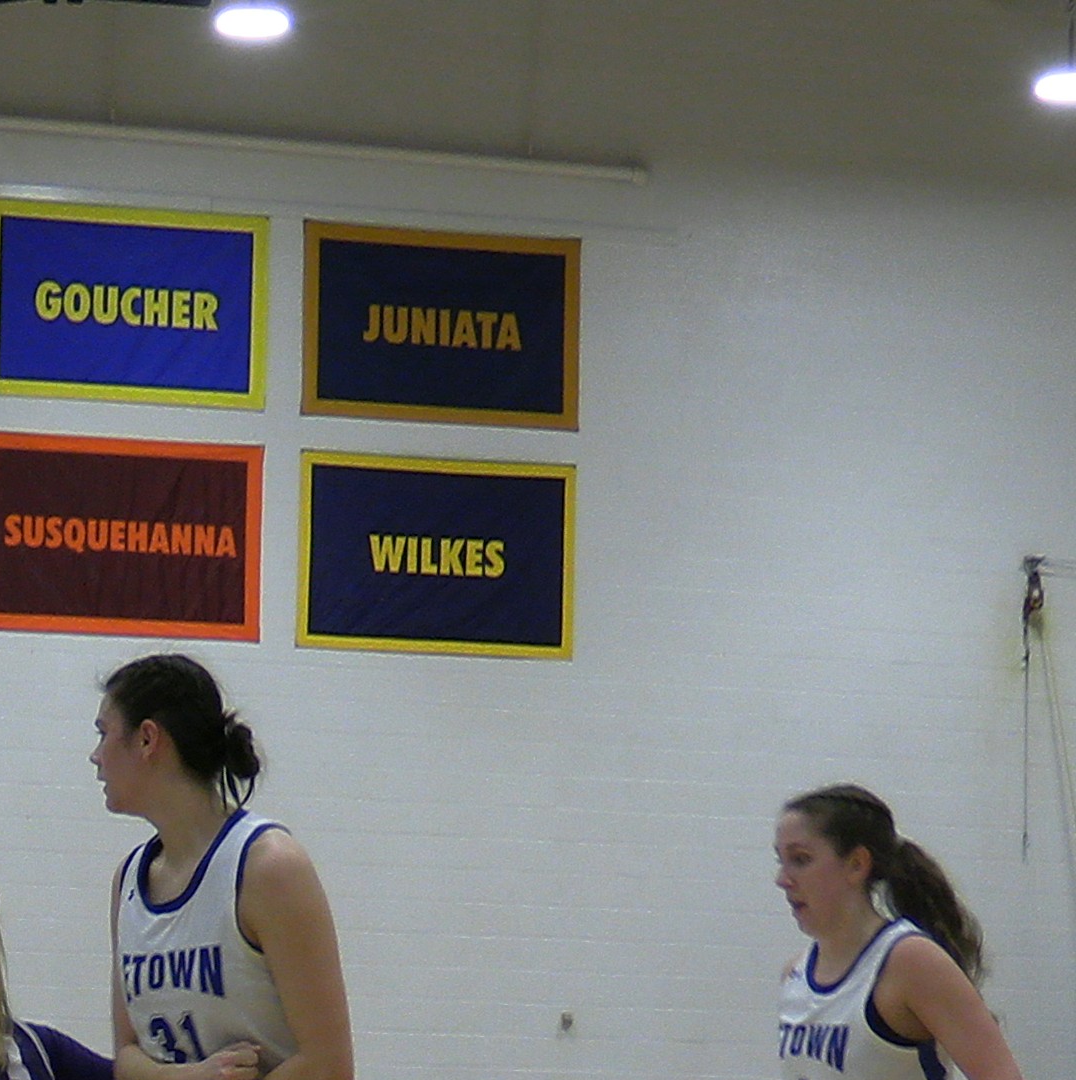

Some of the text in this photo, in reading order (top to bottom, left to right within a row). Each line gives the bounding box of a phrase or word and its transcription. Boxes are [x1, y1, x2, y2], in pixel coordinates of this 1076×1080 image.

[34, 280, 219, 331] GOUCHER
[363, 304, 522, 352] JUNIATA
[3, 514, 236, 558] SUSQUEHANNA
[369, 533, 506, 579] WILKES
